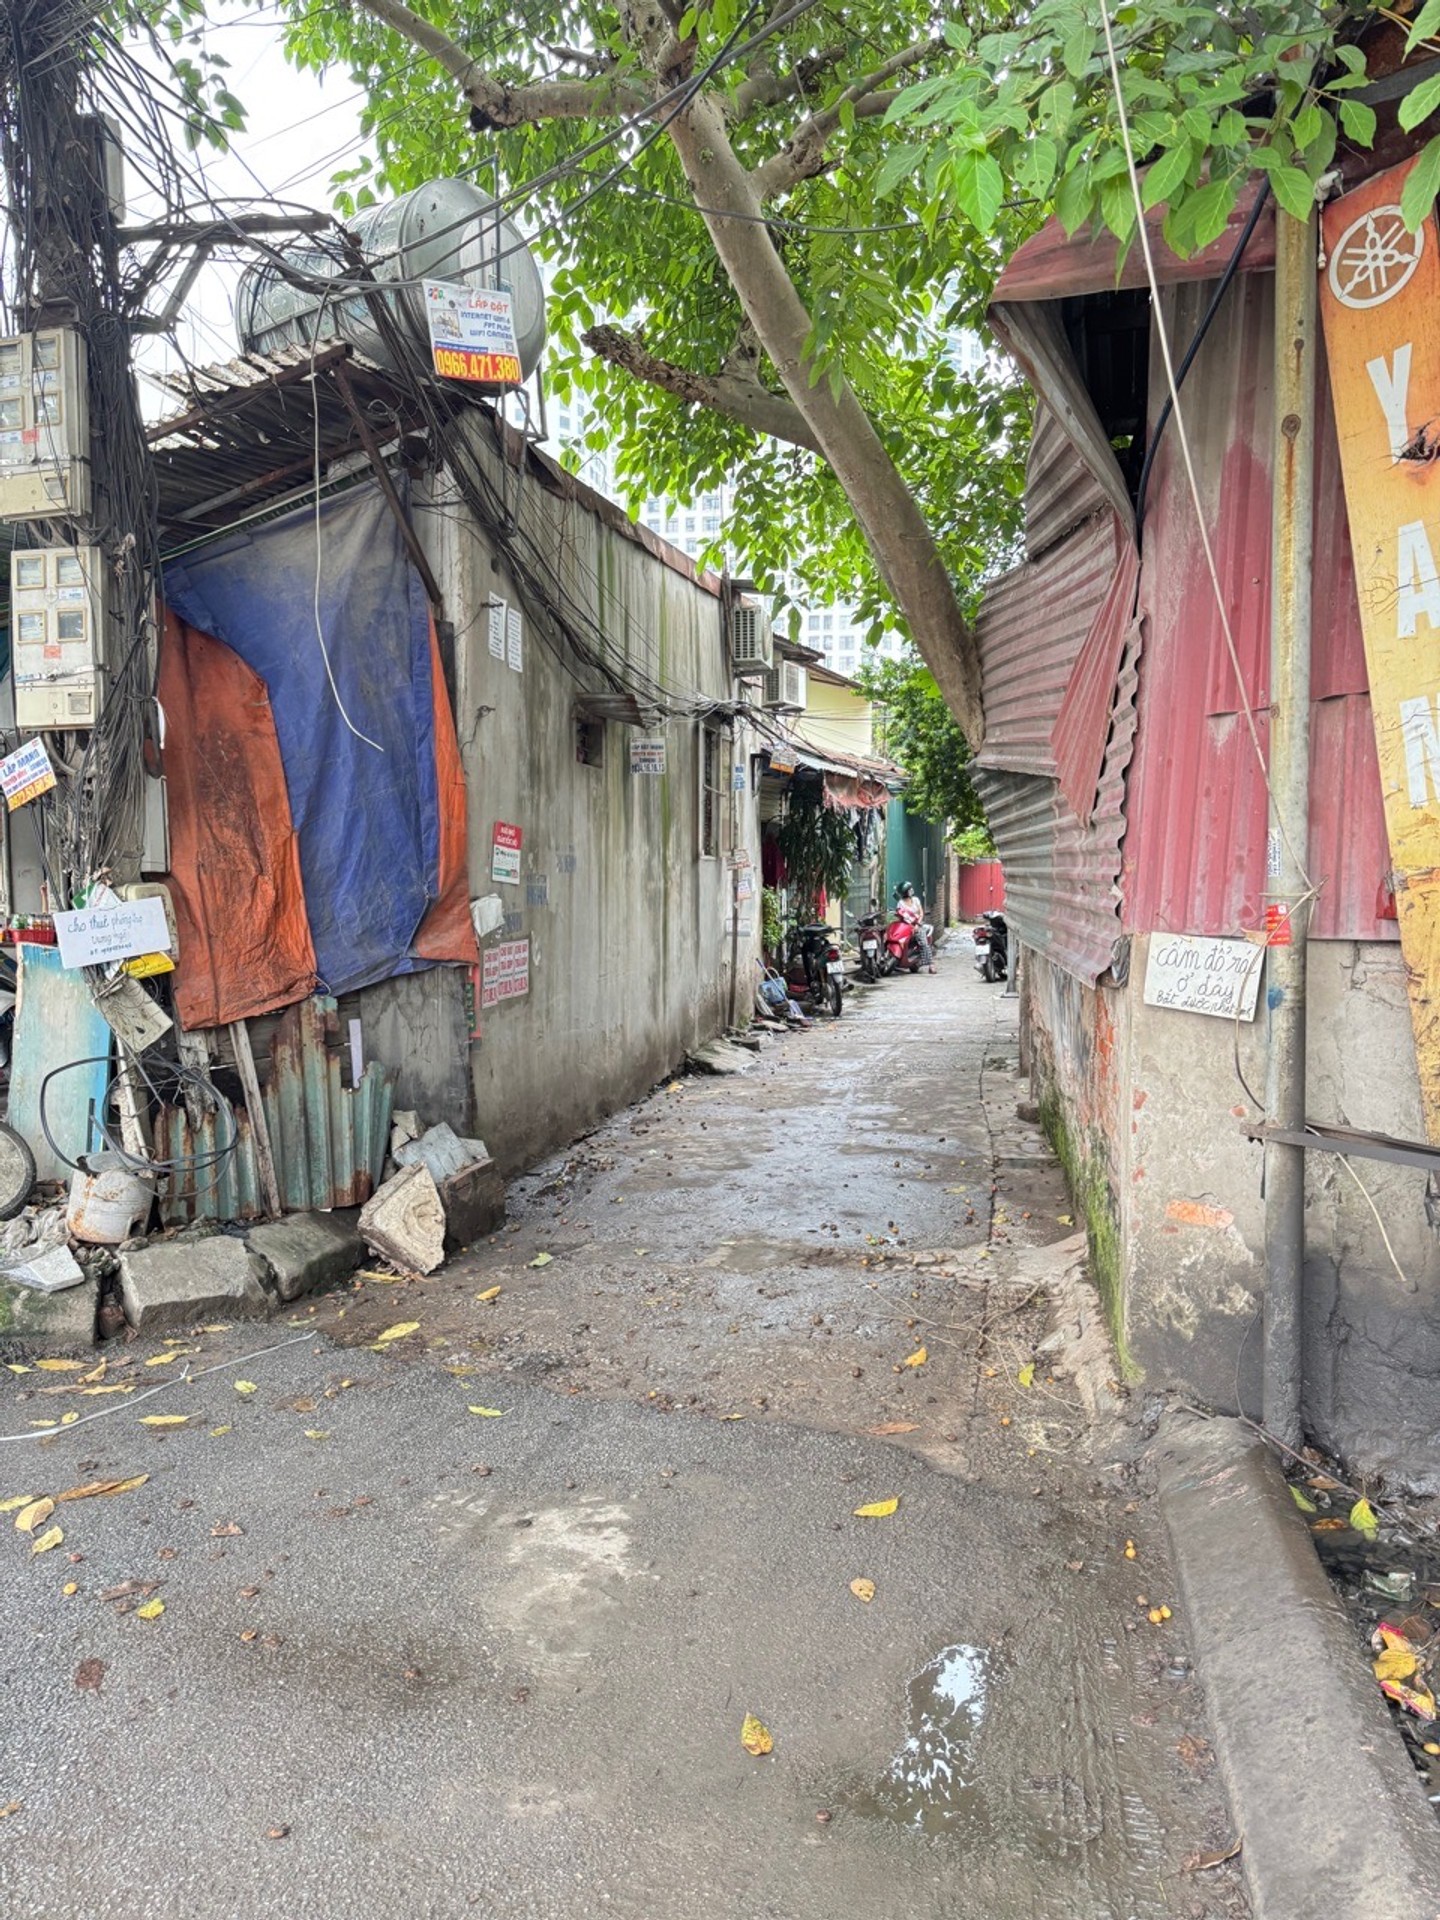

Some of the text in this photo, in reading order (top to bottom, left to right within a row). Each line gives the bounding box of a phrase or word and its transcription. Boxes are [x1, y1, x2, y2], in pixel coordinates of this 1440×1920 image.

[435, 349, 519, 381] 0966.471.380
[67, 916, 87, 933] cho
[1197, 976, 1234, 1004] đây
